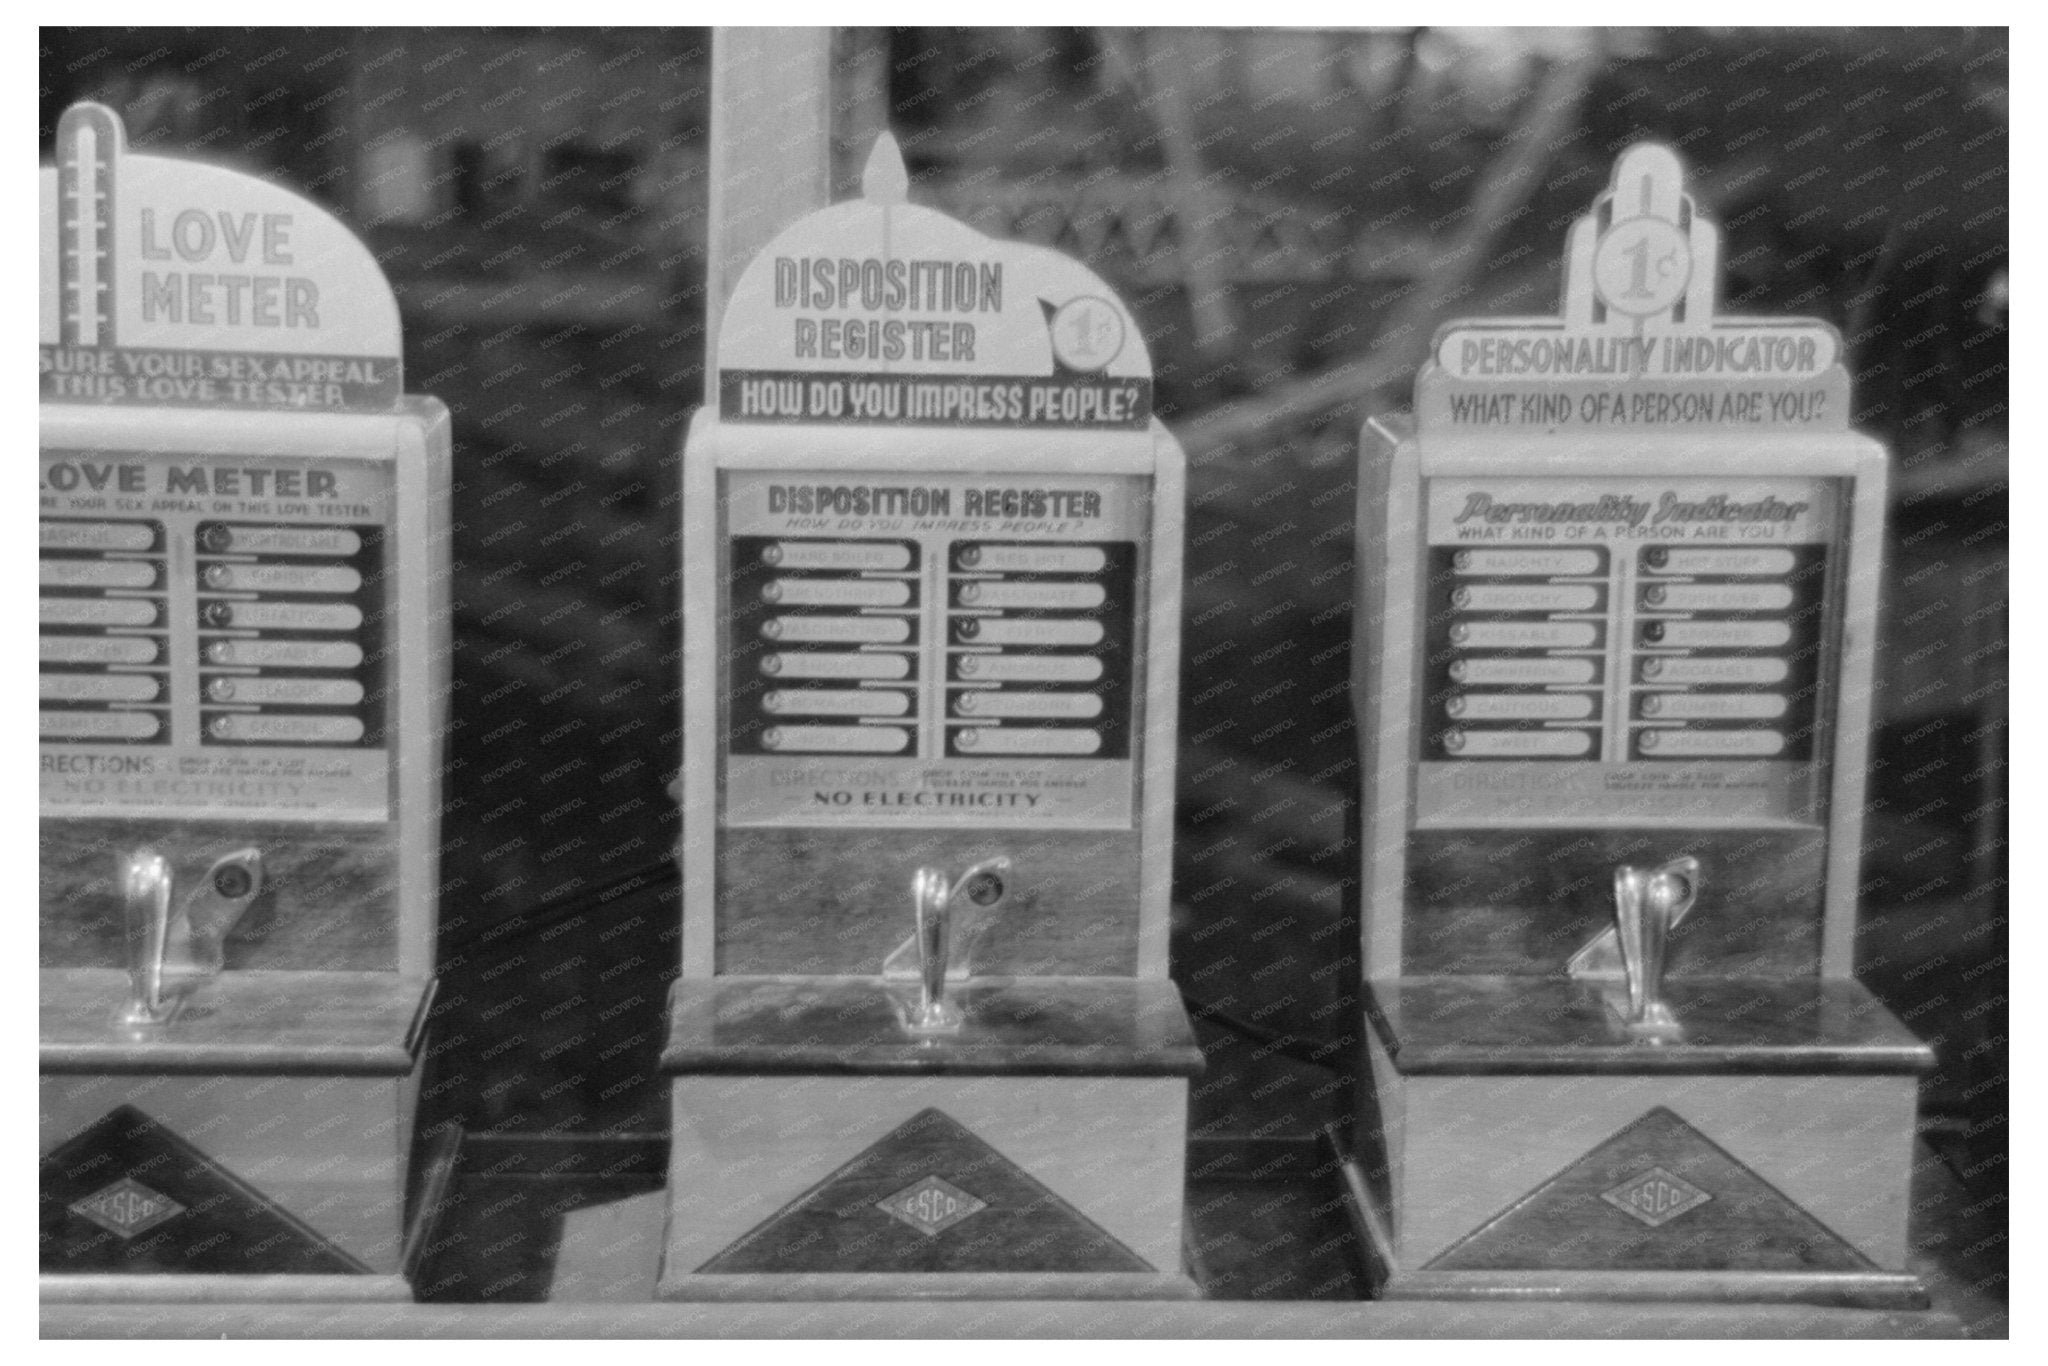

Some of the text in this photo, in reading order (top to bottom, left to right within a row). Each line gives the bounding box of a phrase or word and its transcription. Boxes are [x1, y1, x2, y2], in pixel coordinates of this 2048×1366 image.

[141, 207, 294, 265] LOVE
[142, 270, 320, 329] METER
[775, 257, 1003, 313] DISPOSITION
[794, 319, 976, 361] REGISTER
[1461, 336, 1816, 375] PERSONALITY INDICATOR
[123, 353, 203, 377] YOUR
[211, 355, 267, 379] SEX
[267, 358, 380, 384] APPEAL
[53, 373, 344, 406] THIS LOVE TESTER
[742, 380, 1139, 422] HOW DO YOU IMPRESS PEOPLE?
[1450, 390, 1826, 424] WHAT KIND OF A PERSON ARE YOU?
[39, 461, 338, 498] OVE METER
[115, 499, 143, 511] SEX
[152, 500, 204, 513] APPEAL
[213, 502, 232, 513] ON
[240, 502, 271, 515] THIS
[277, 503, 309, 516] LOVE
[319, 504, 370, 517] TESTER
[769, 485, 1101, 518] DISPOSITION REGISTER
[1453, 490, 1808, 528] Personality Indicator
[786, 519, 830, 529] HOW
[838, 519, 861, 530] DO
[868, 520, 902, 531] YOU
[912, 521, 991, 532] IMPRESS
[1457, 526, 1503, 540] WHAT
[1512, 526, 1556, 539] KIND
[1565, 526, 1587, 539] OF
[1595, 526, 1607, 539] A
[1615, 526, 1685, 540] PERSON
[1694, 526, 1728, 539] ARE
[813, 789, 1042, 808] NO ELECTRICITY
